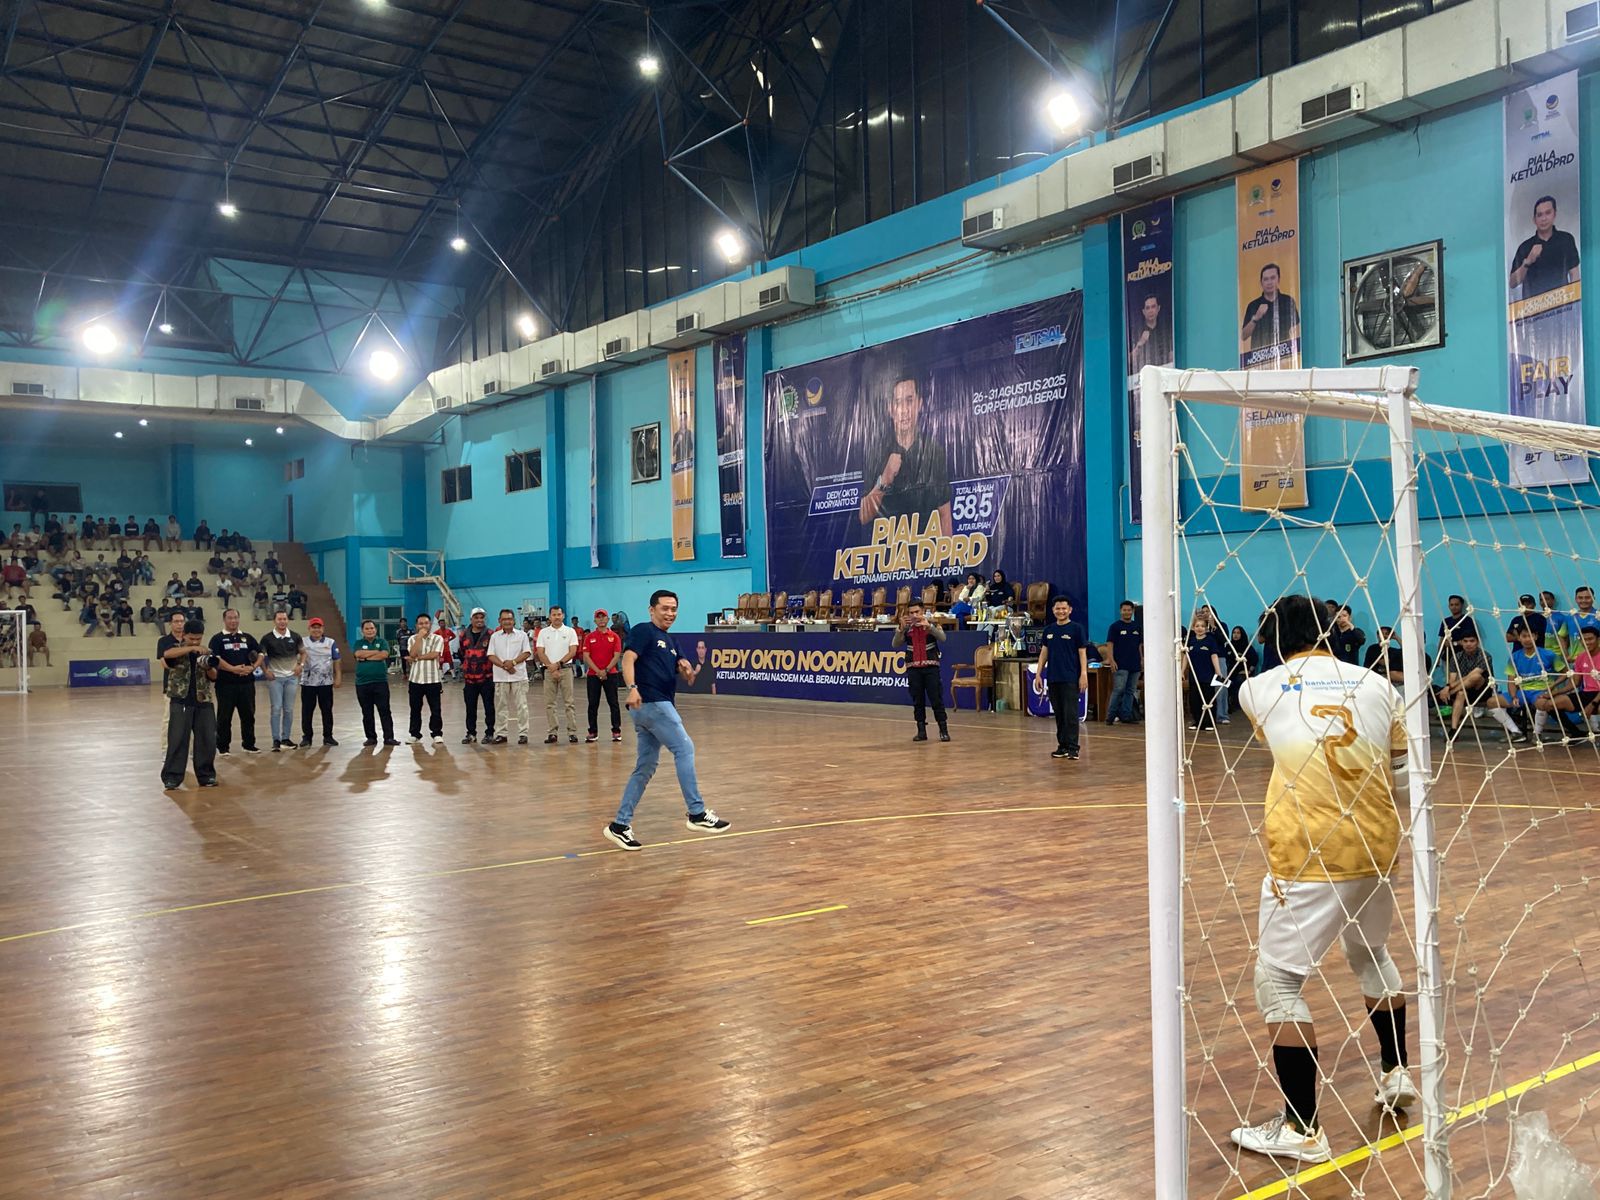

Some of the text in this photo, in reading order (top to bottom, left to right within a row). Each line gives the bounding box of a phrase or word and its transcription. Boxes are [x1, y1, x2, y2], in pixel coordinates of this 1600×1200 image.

[1511, 153, 1574, 183] KETUA DPRD
[1528, 150, 1555, 168] PIALA
[1242, 229, 1295, 251] KETUA DPRD
[1256, 226, 1279, 239] PIALA
[1015, 325, 1065, 350] FUTSAL
[1521, 356, 1570, 383] FAIR
[972, 391, 983, 404] 26
[988, 388, 998, 400] 31
[998, 379, 1041, 398] AGUSTUS
[1042, 374, 1066, 390] 2025
[1520, 374, 1573, 400] PLAY
[974, 387, 1067, 415] GOR PEMUDA BERAU
[815, 498, 849, 510] NOORYANTO
[826, 488, 858, 500] DEDY OKTO
[952, 492, 993, 522] 58,5
[871, 510, 942, 546] PIALA
[957, 523, 971, 531] JUTA
[833, 532, 988, 580] KETUA DPRD
[853, 571, 892, 584] TURNAMEN
[892, 570, 918, 581] FUTSAL
[924, 567, 942, 578] FULL
[942, 566, 964, 577] OPEN
[710, 649, 750, 669] DEDY
[751, 650, 795, 672] OKTO
[716, 671, 735, 680] KETUA
[736, 672, 749, 681] DPD
[750, 672, 770, 682] PARTAI
[771, 673, 799, 683] NASDEM
[815, 674, 839, 685] BERAU
[839, 676, 846, 684] &
[846, 676, 870, 686] KETUA
[872, 677, 894, 687] DPRD
